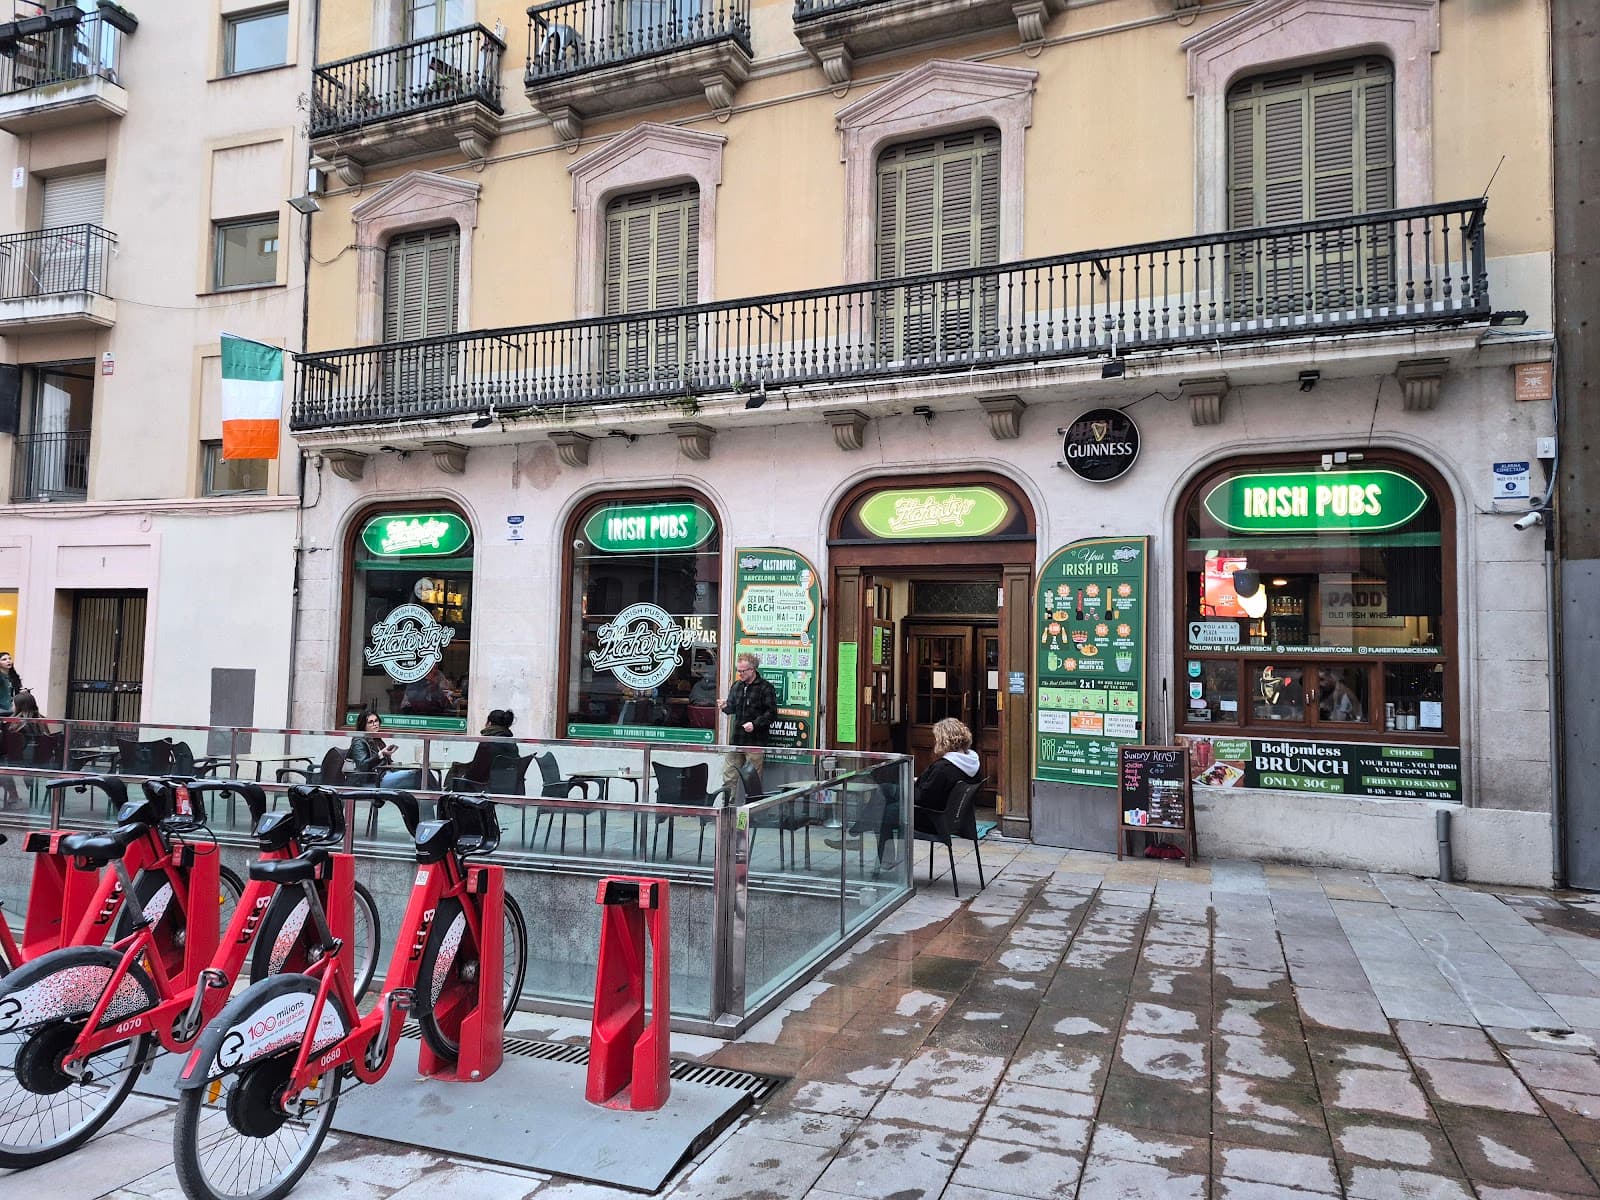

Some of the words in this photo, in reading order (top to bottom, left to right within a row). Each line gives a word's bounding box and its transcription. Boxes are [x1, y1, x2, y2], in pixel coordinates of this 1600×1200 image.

[1067, 441, 1132, 458] GUINNESS
[1243, 486, 1309, 518] IRISH
[1315, 484, 1382, 517] PUBS
[608, 516, 646, 541] IRISH
[650, 514, 688, 540] PUBS
[1077, 547, 1104, 563] Your
[763, 559, 797, 571] GASTROPUBS
[1062, 563, 1092, 575] IRISH
[1096, 562, 1119, 575] PUB
[747, 595, 758, 604] SEX
[765, 595, 775, 603] THE
[1328, 591, 1388, 607] PADD
[393, 608, 410, 619] IRISH
[411, 608, 428, 620] PUBS
[622, 608, 643, 621] IRISH
[644, 607, 665, 621] PUBS
[747, 603, 775, 612] BEACH
[1328, 611, 1344, 619] OLD
[1346, 611, 1366, 619] IRISH
[683, 616, 703, 629] THE
[364, 620, 455, 666] Flaherty's
[589, 622, 697, 671] Flaherty's
[1286, 646, 1353, 654] WWW.PFLAHERTY.COM
[391, 663, 428, 678] BARCELONA
[621, 667, 667, 685] BARCELONA
[1079, 679, 1095, 689] 2x1
[784, 721, 798, 730] ALL
[1057, 746, 1085, 757] Draught
[1124, 750, 1151, 762] SUNDAY
[1261, 742, 1341, 757] Bottomless
[1390, 749, 1425, 757] CHOOSE
[1255, 756, 1349, 775] BRUNCH
[1360, 759, 1383, 767] YOUR
[1399, 768, 1441, 776] COCKTAIL
[1263, 776, 1300, 787] ONLY
[1303, 778, 1329, 789] 30€
[1366, 777, 1398, 785] FRIDAY
[1413, 780, 1450, 788] SUNDAY
[236, 895, 272, 945] bicing
[409, 908, 436, 961] bicing
[116, 1018, 142, 1034] 4070
[247, 1015, 277, 1040] 100
[276, 1000, 304, 1019] milions
[320, 1048, 341, 1067] 0680
